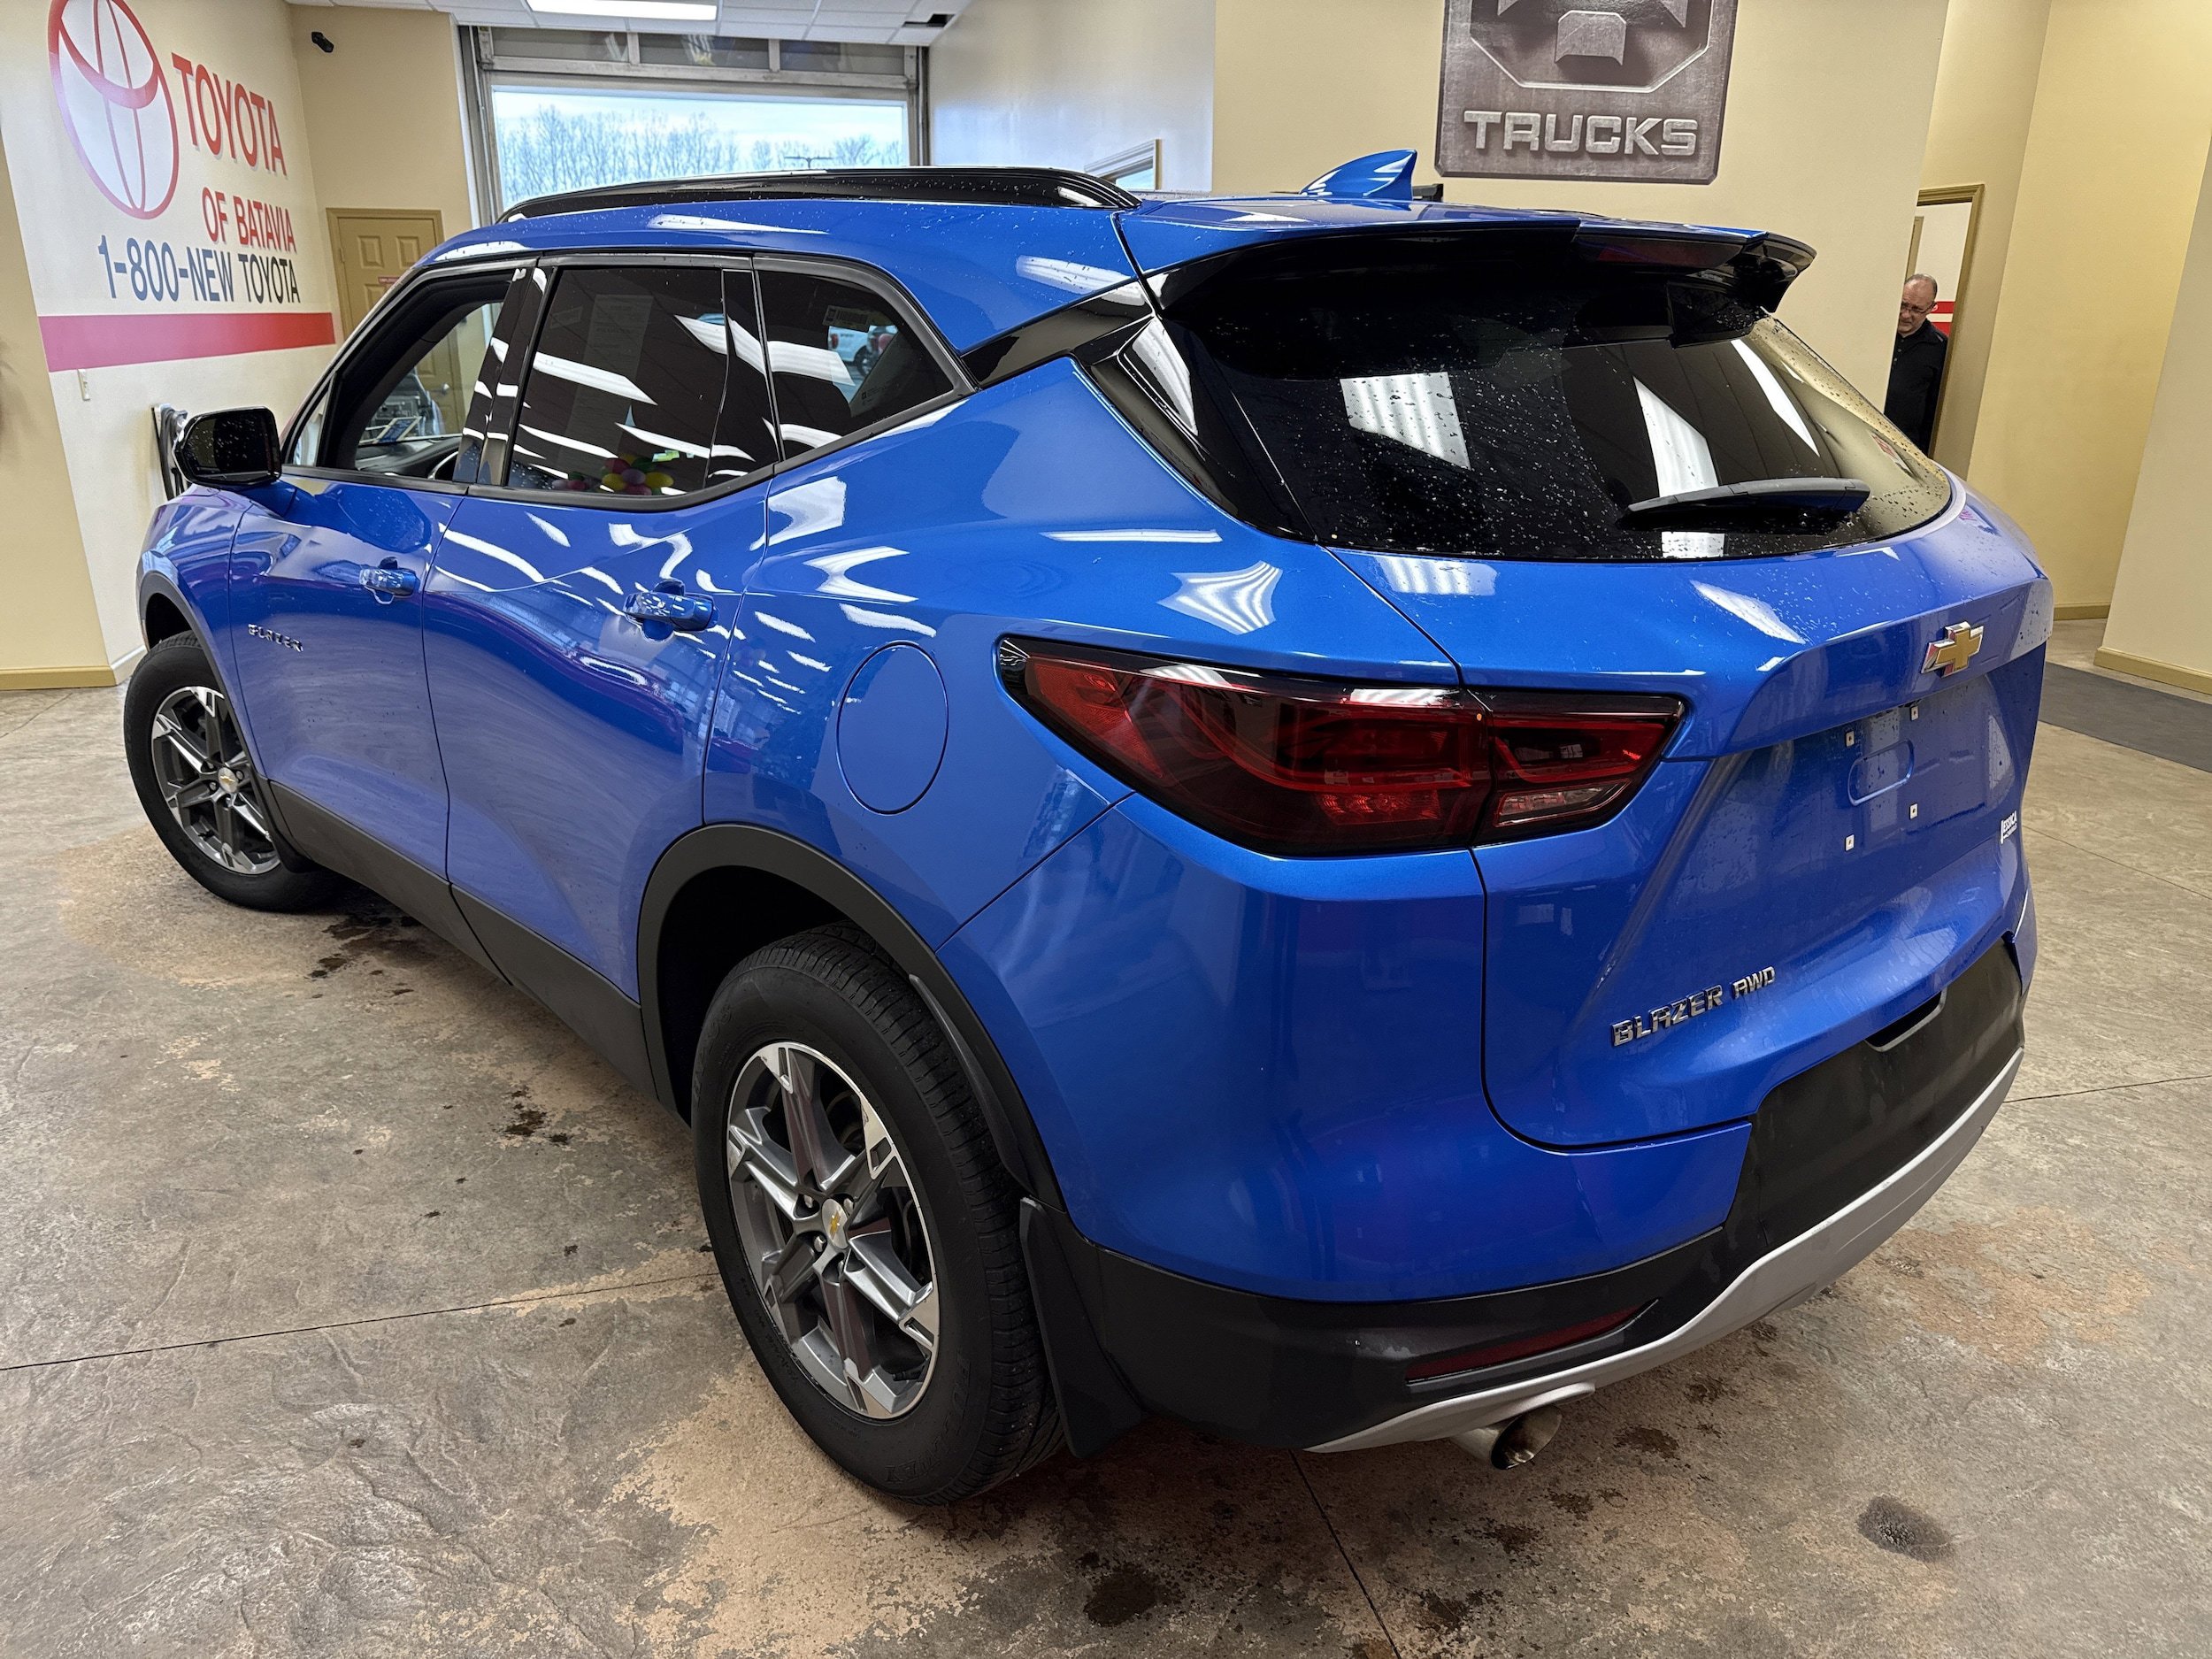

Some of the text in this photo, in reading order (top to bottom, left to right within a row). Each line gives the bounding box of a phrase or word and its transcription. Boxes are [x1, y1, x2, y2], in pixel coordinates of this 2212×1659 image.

[171, 52, 288, 176] TOYOTA
[1463, 111, 1698, 157] TRUCKS
[202, 187, 297, 253] OF BATAVIA
[98, 234, 301, 303] 1-800-NEW TOYOTA
[248, 623, 303, 652] BLAZER
[1611, 965, 1776, 1046] BLAZER AWD
